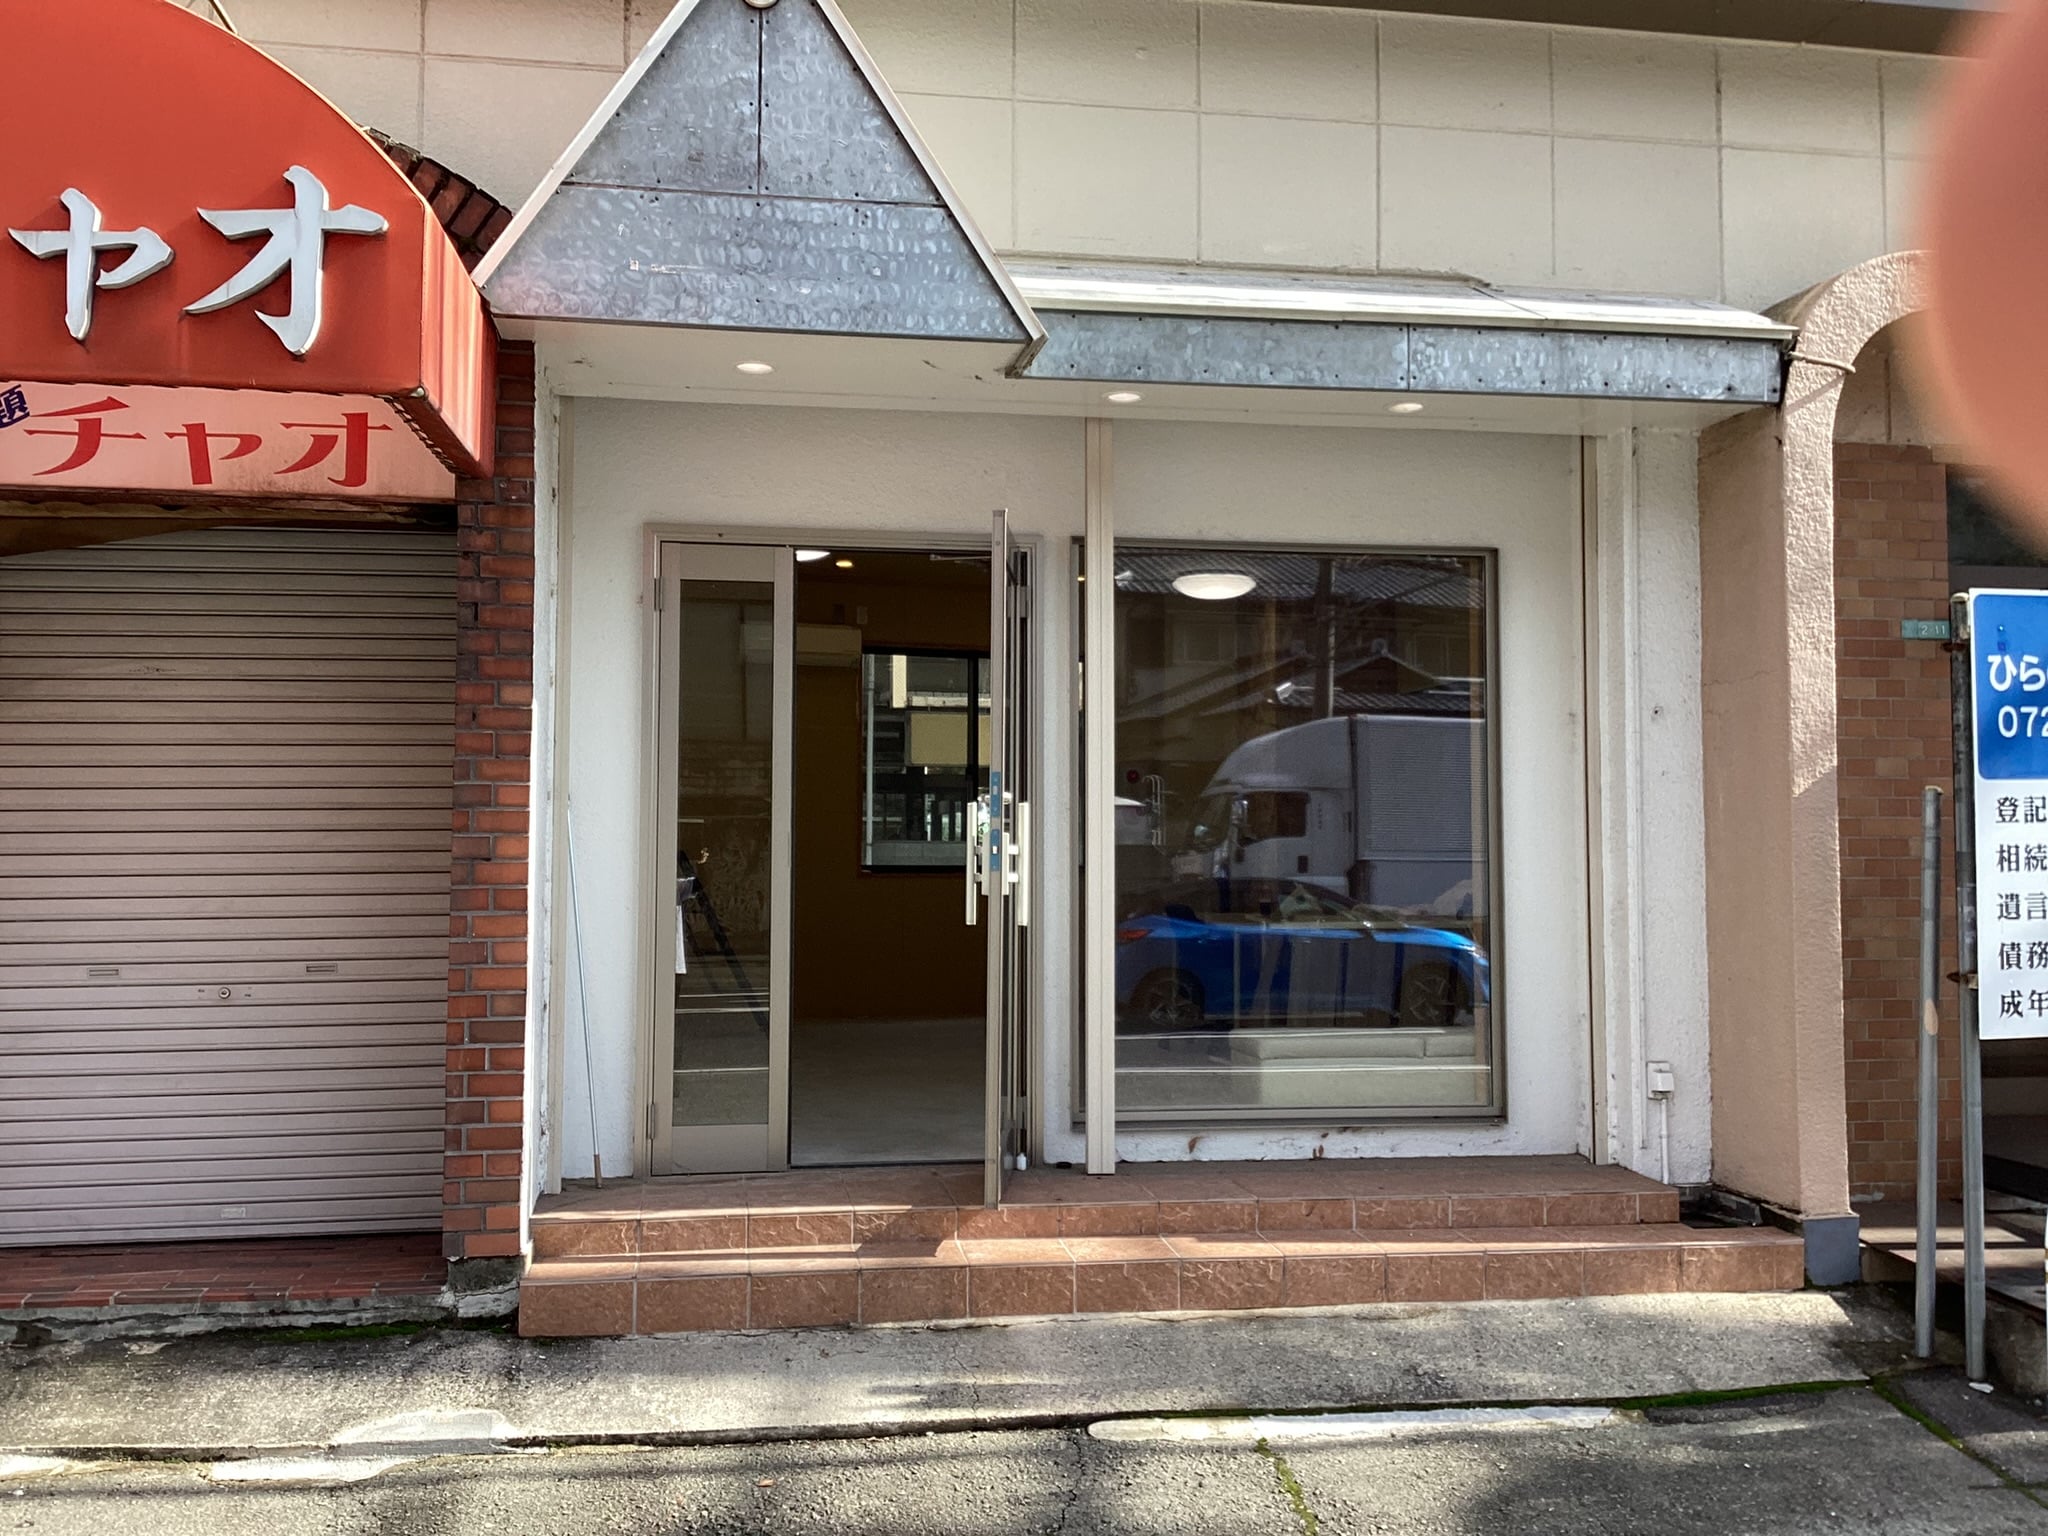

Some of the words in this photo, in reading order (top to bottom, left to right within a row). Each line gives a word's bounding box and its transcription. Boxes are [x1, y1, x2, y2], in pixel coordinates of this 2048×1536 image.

[24, 396, 394, 488] チャオ
[1987, 654, 2048, 692] ひら
[1995, 796, 2048, 824] 登記
[1995, 844, 2048, 872] 相続
[1996, 892, 2048, 920] 遺言
[1998, 941, 2048, 970] 債務
[2000, 989, 2048, 1018] 成年
